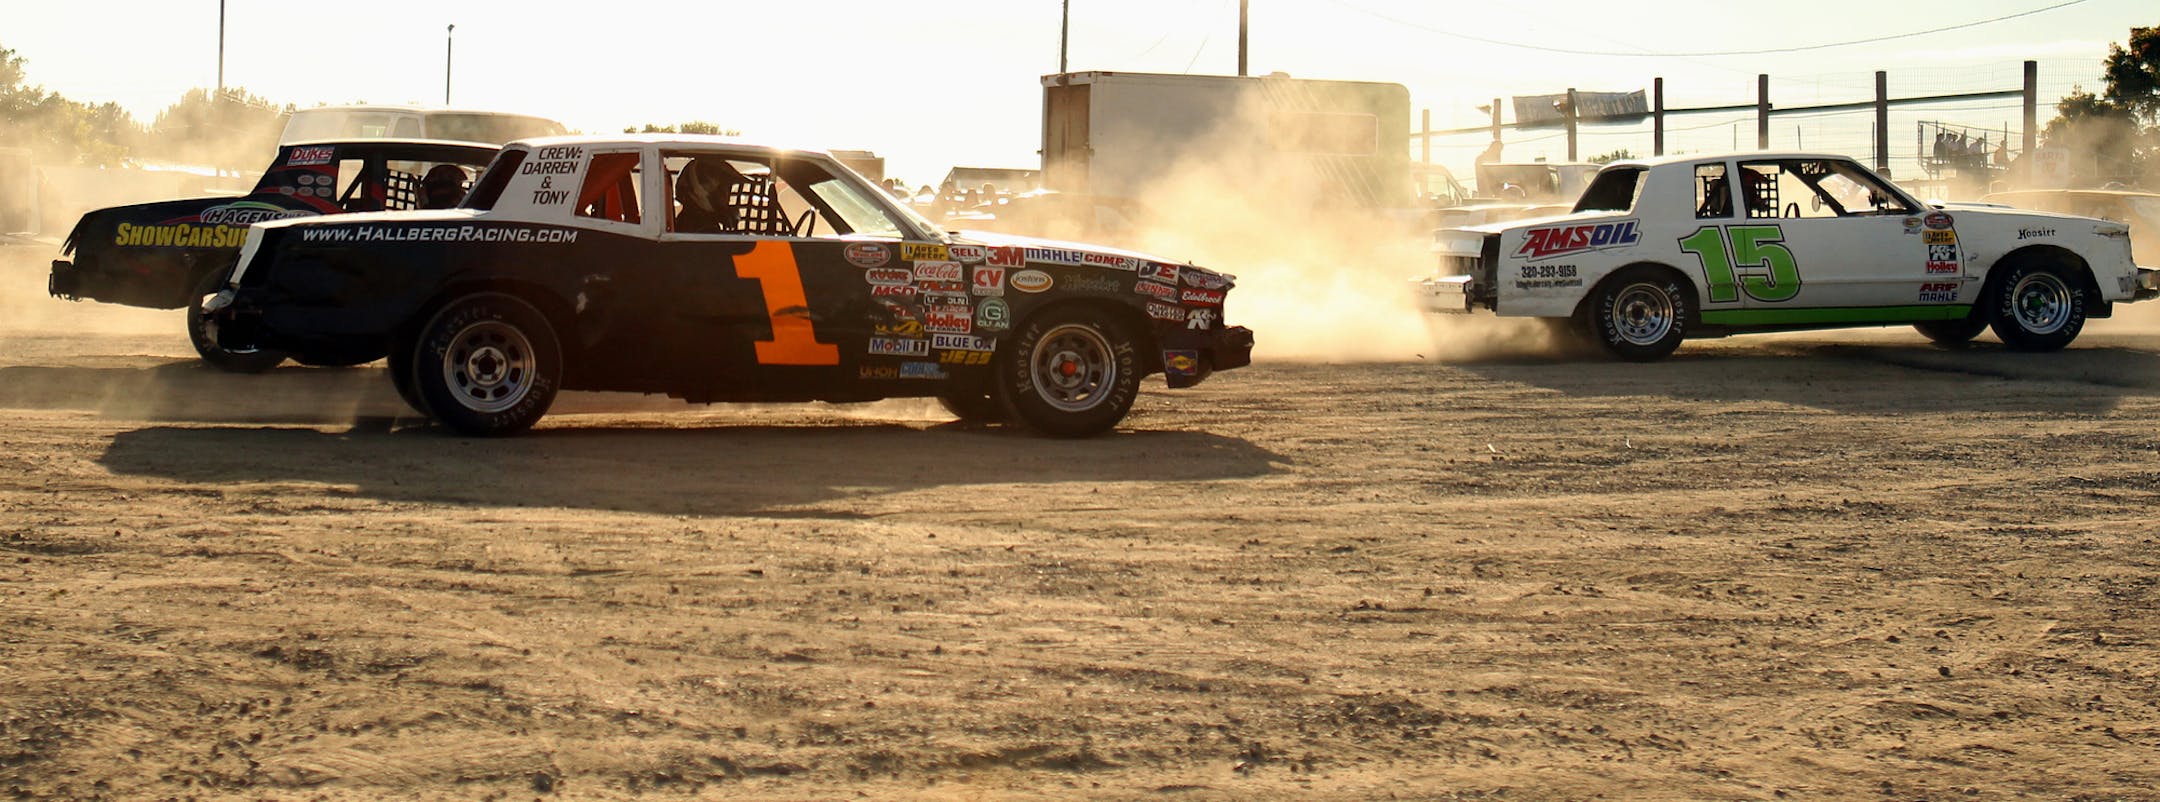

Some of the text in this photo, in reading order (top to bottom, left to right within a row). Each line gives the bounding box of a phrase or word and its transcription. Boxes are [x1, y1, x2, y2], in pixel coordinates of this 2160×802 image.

[539, 147, 583, 160] CREW:
[522, 161, 579, 175] DARREN
[541, 176, 552, 189] &
[533, 191, 570, 205] TONY
[1520, 221, 1639, 258] AMSOIL
[2017, 228, 2057, 240] Hoosier
[987, 247, 1024, 266] 3M
[1026, 248, 1080, 263] MAHLE
[1084, 254, 1124, 268] COMP
[1677, 224, 1802, 303] 15
[1926, 261, 1957, 272] Holley
[975, 269, 1002, 288] CV
[1920, 283, 1958, 292] ARP
[731, 240, 840, 365] 1
[1919, 292, 1957, 302] MAHLE
[926, 312, 970, 333] Holley
[872, 339, 911, 352] Mobil
[936, 336, 970, 348] BLUE
